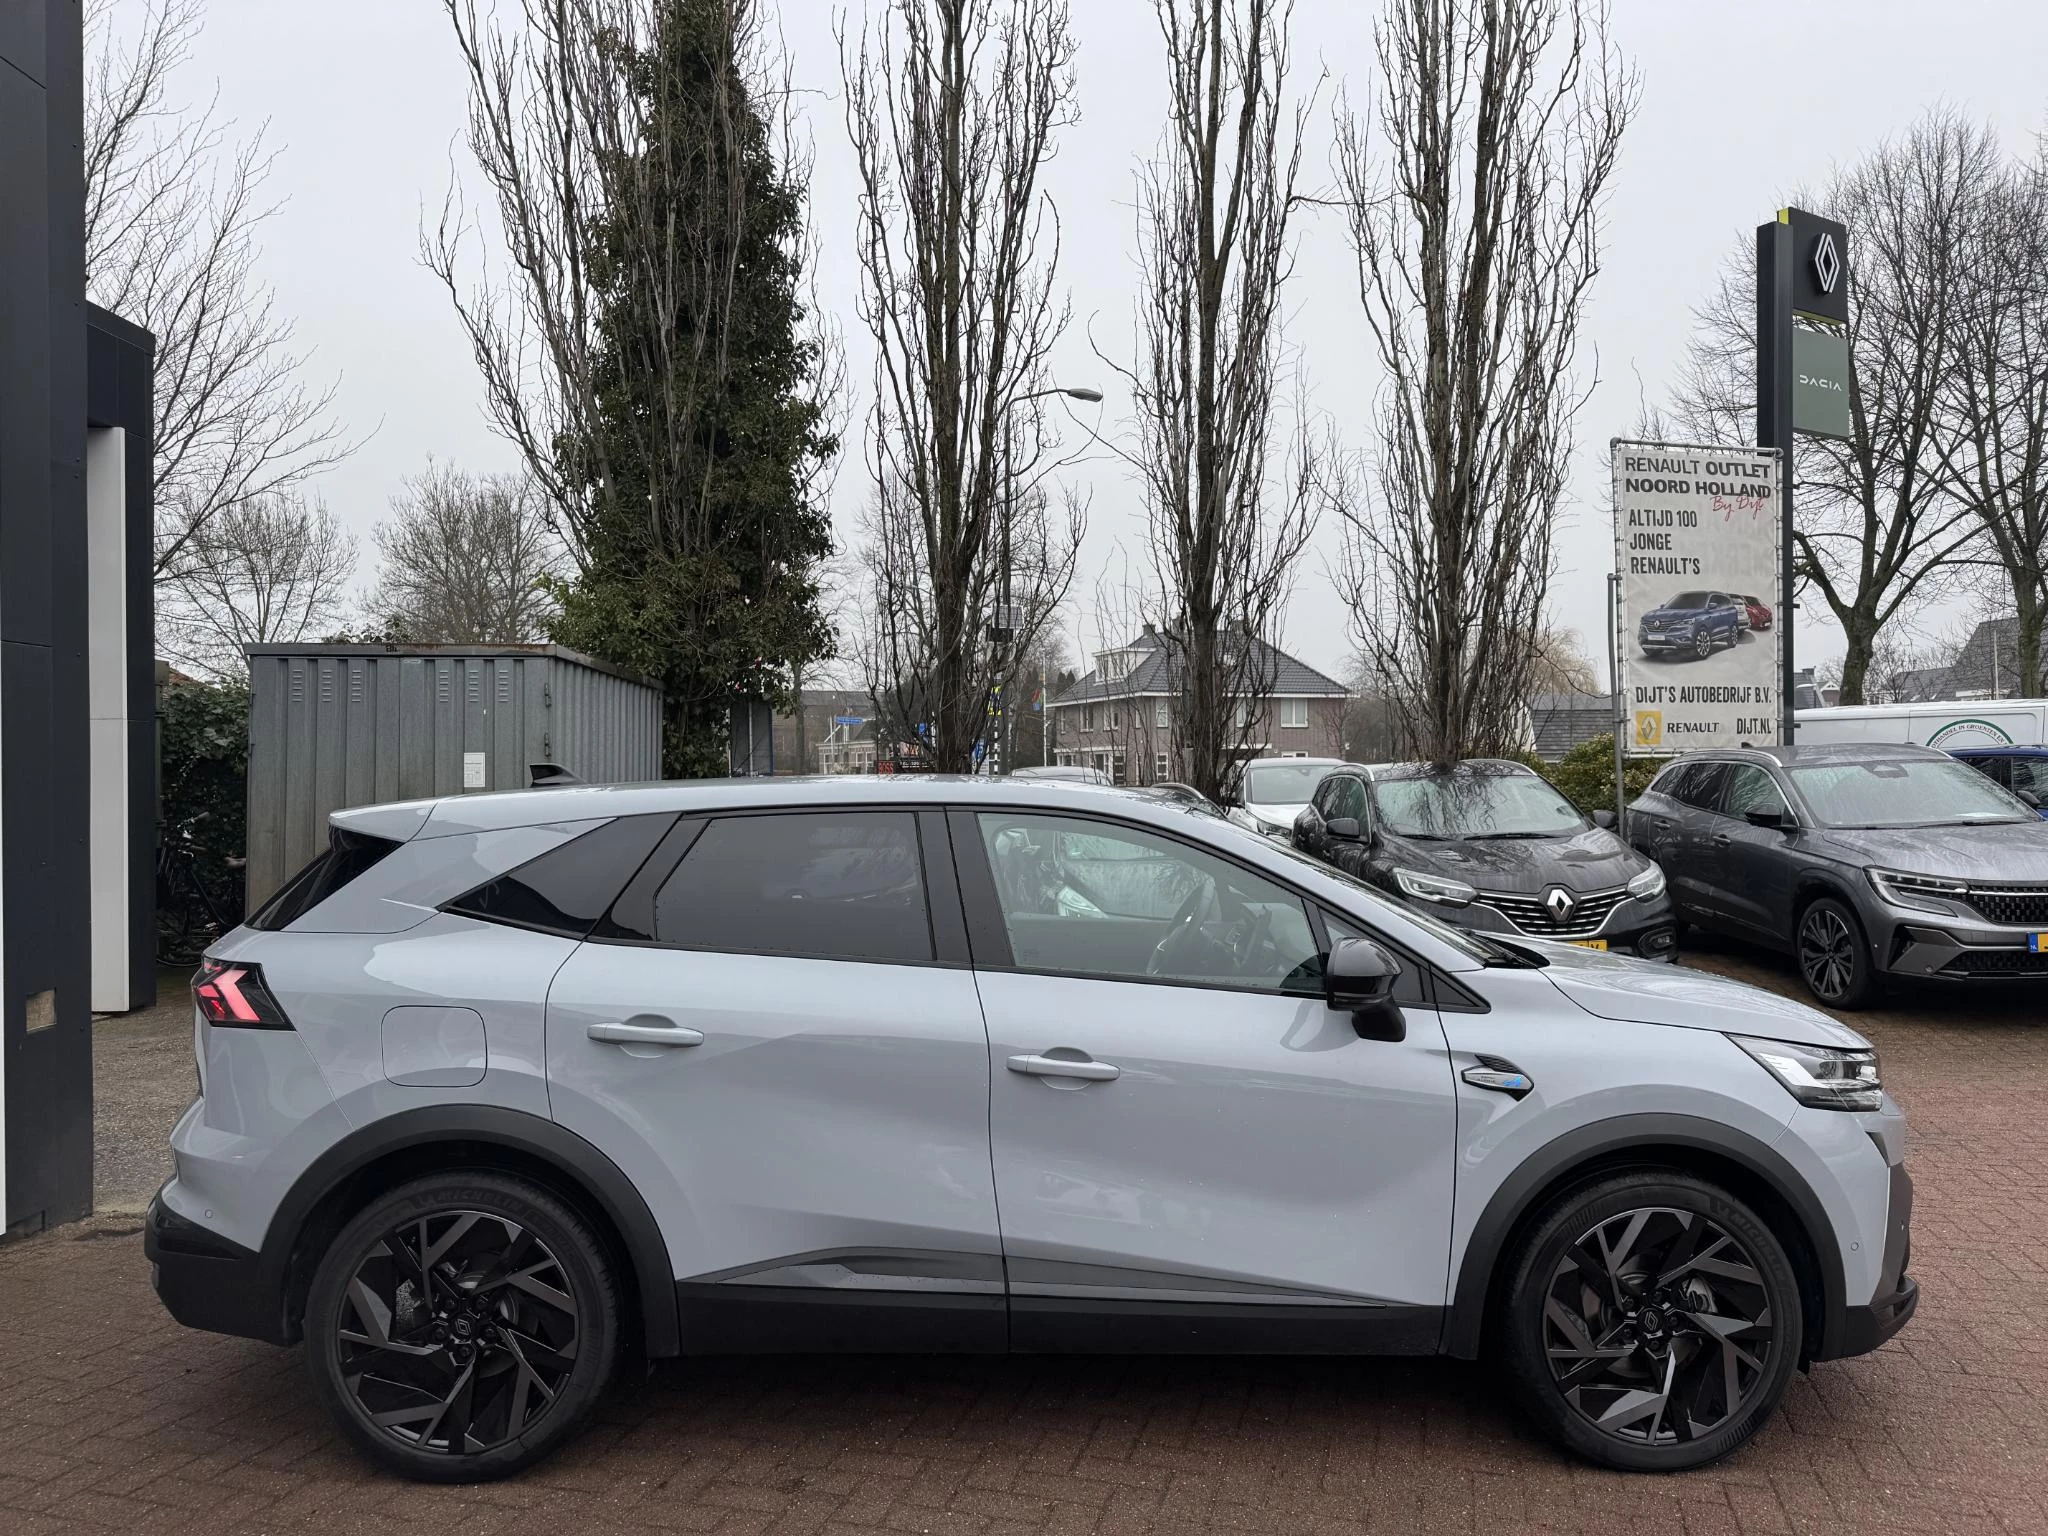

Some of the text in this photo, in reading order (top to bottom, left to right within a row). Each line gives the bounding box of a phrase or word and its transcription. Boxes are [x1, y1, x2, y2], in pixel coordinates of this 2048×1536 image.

[1799, 374, 1842, 392] DACIA
[1625, 457, 1771, 478] RENAULT OUTLET
[1625, 478, 1771, 498] NOORD HOLLAND
[1709, 495, 1734, 521] By
[1628, 509, 1673, 527] ALTIJD
[1677, 510, 1698, 528] 100
[1629, 533, 1672, 550] JONGE
[1630, 556, 1700, 575] RENAULT'S
[1635, 686, 1772, 704] DIJT'S AUTOBEDRIJF B.V.
[1667, 718, 1772, 735] RENAULT DIJT.NL
[1931, 727, 1957, 748] OTHANDEL
[438, 1190, 523, 1211] MICHELIN
